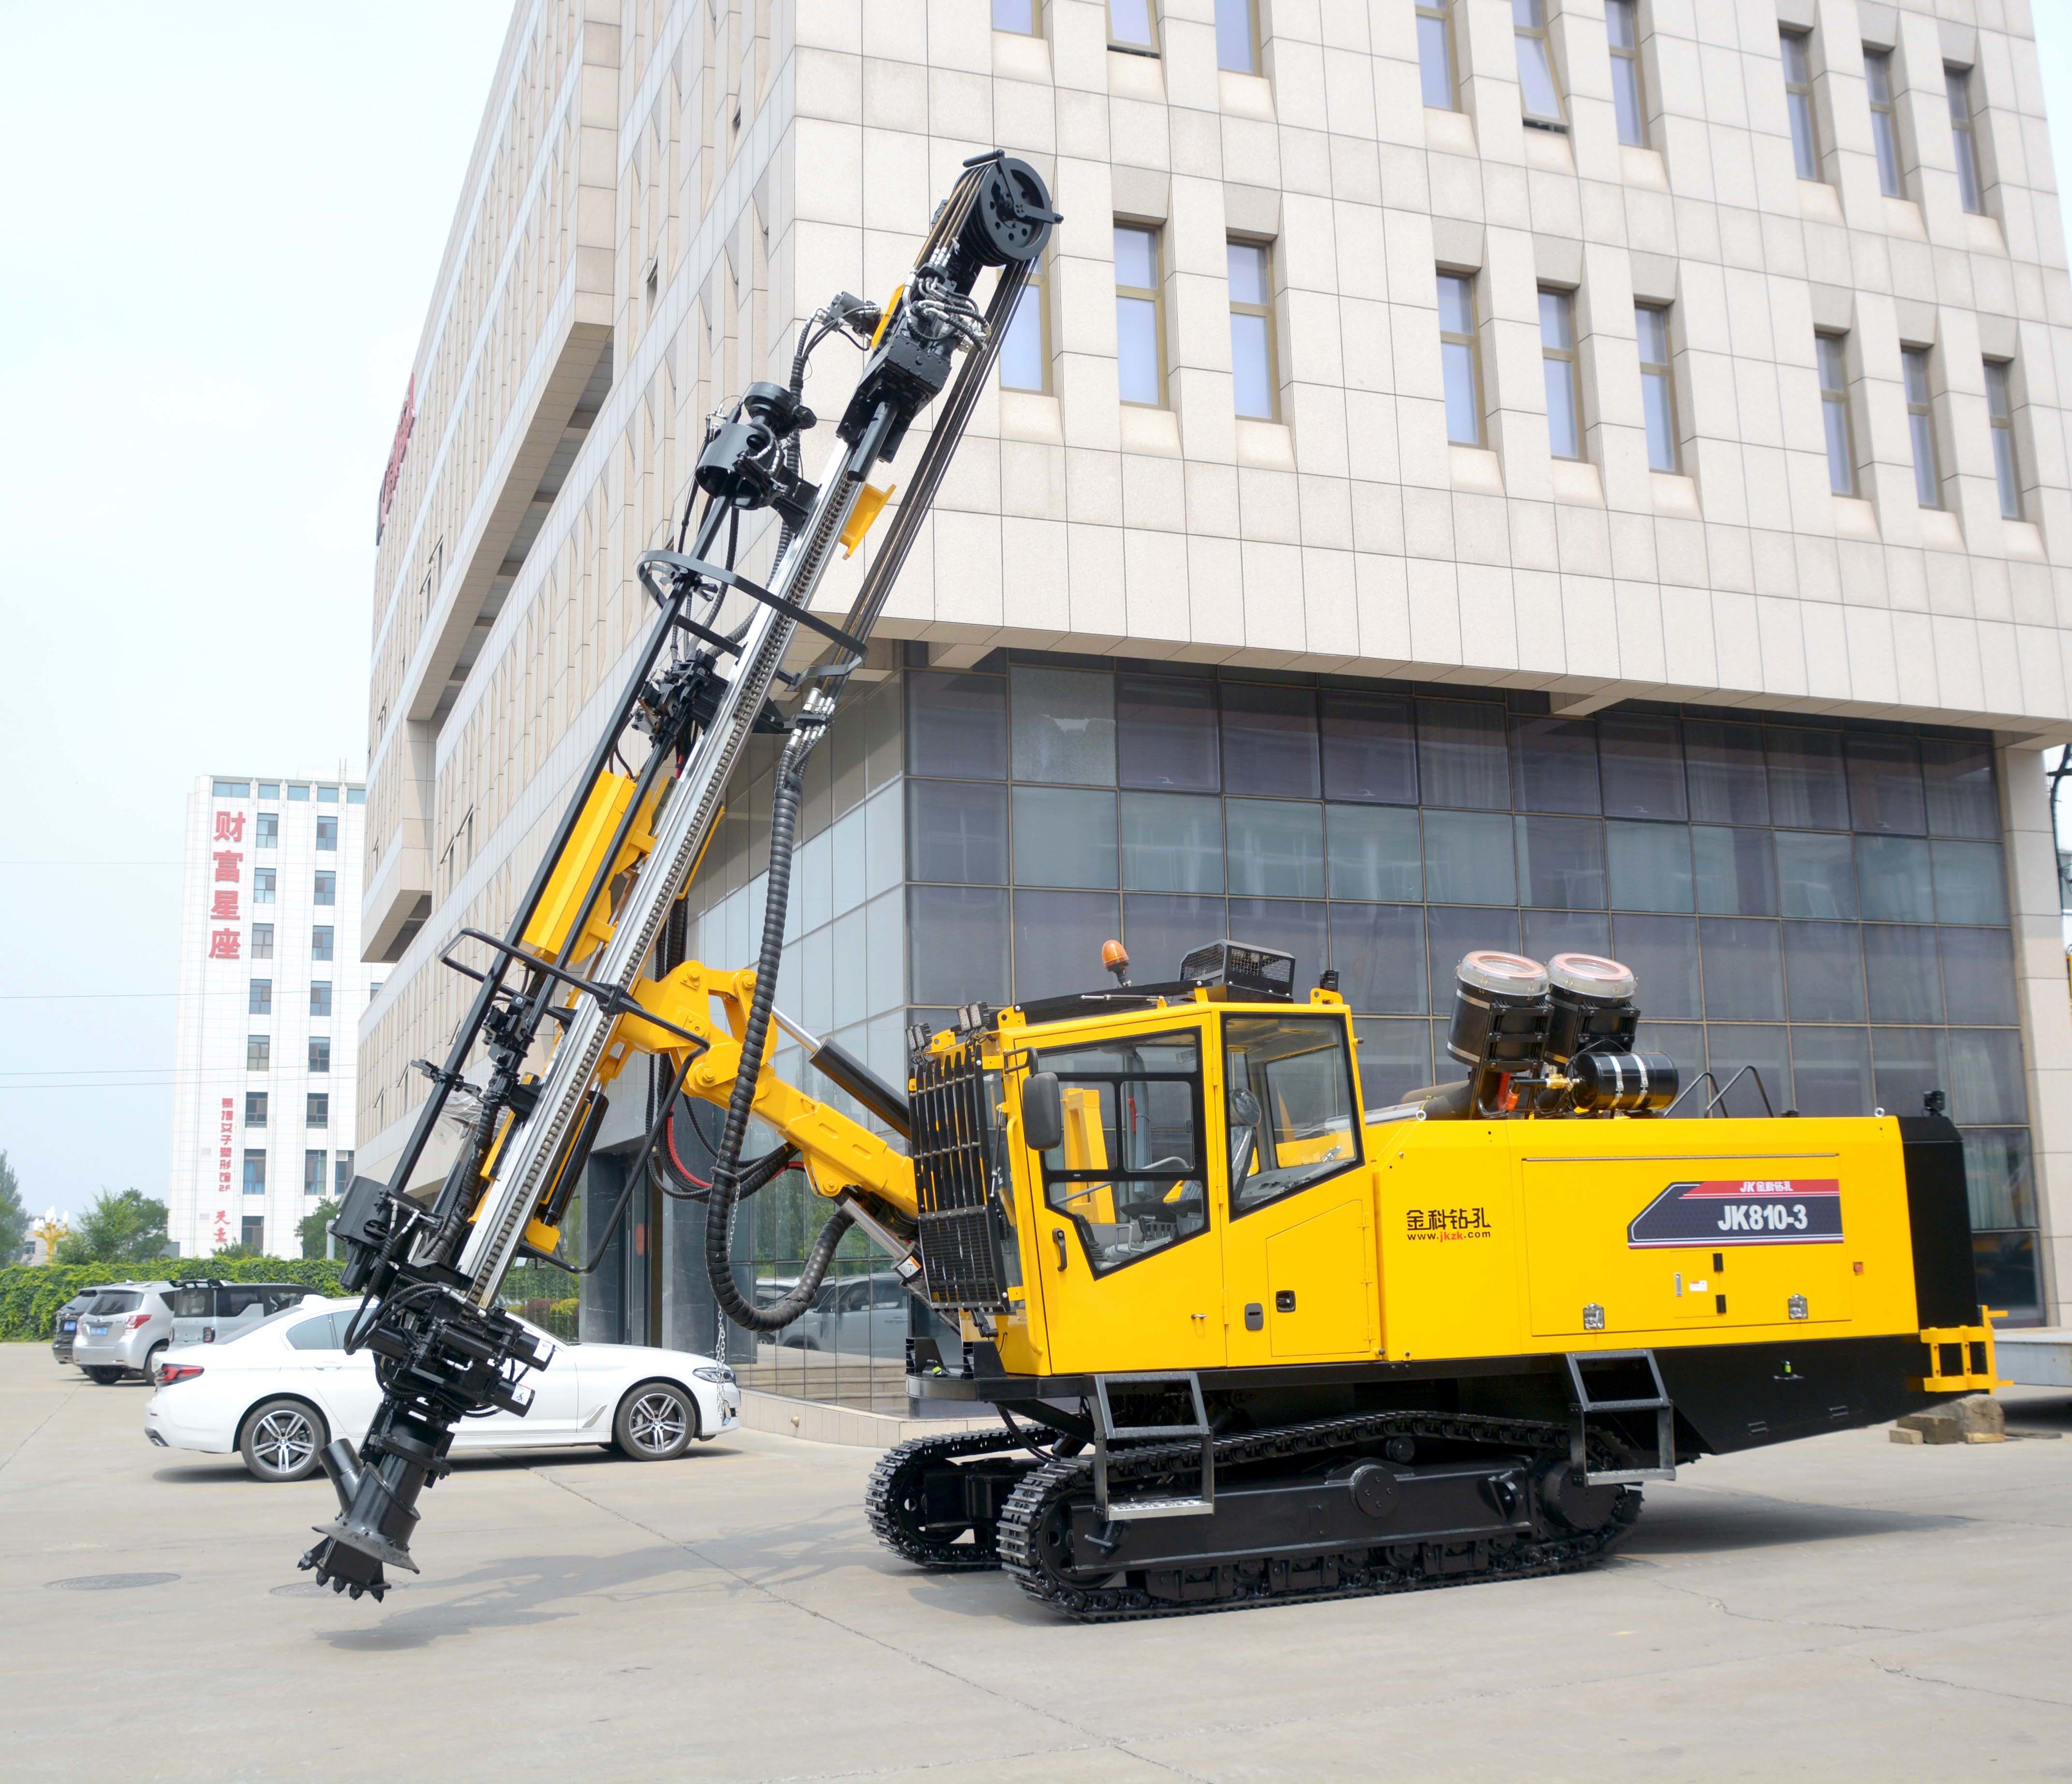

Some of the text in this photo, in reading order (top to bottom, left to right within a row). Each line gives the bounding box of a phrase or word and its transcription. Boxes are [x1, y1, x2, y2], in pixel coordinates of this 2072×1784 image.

[208, 811, 246, 959] 财富星座
[1740, 1181, 1756, 1192] JK
[1406, 1207, 1492, 1231] 金科钻孔
[1717, 1204, 1808, 1231] JK810-3
[1407, 1231, 1491, 1242] www.jkzk.com
